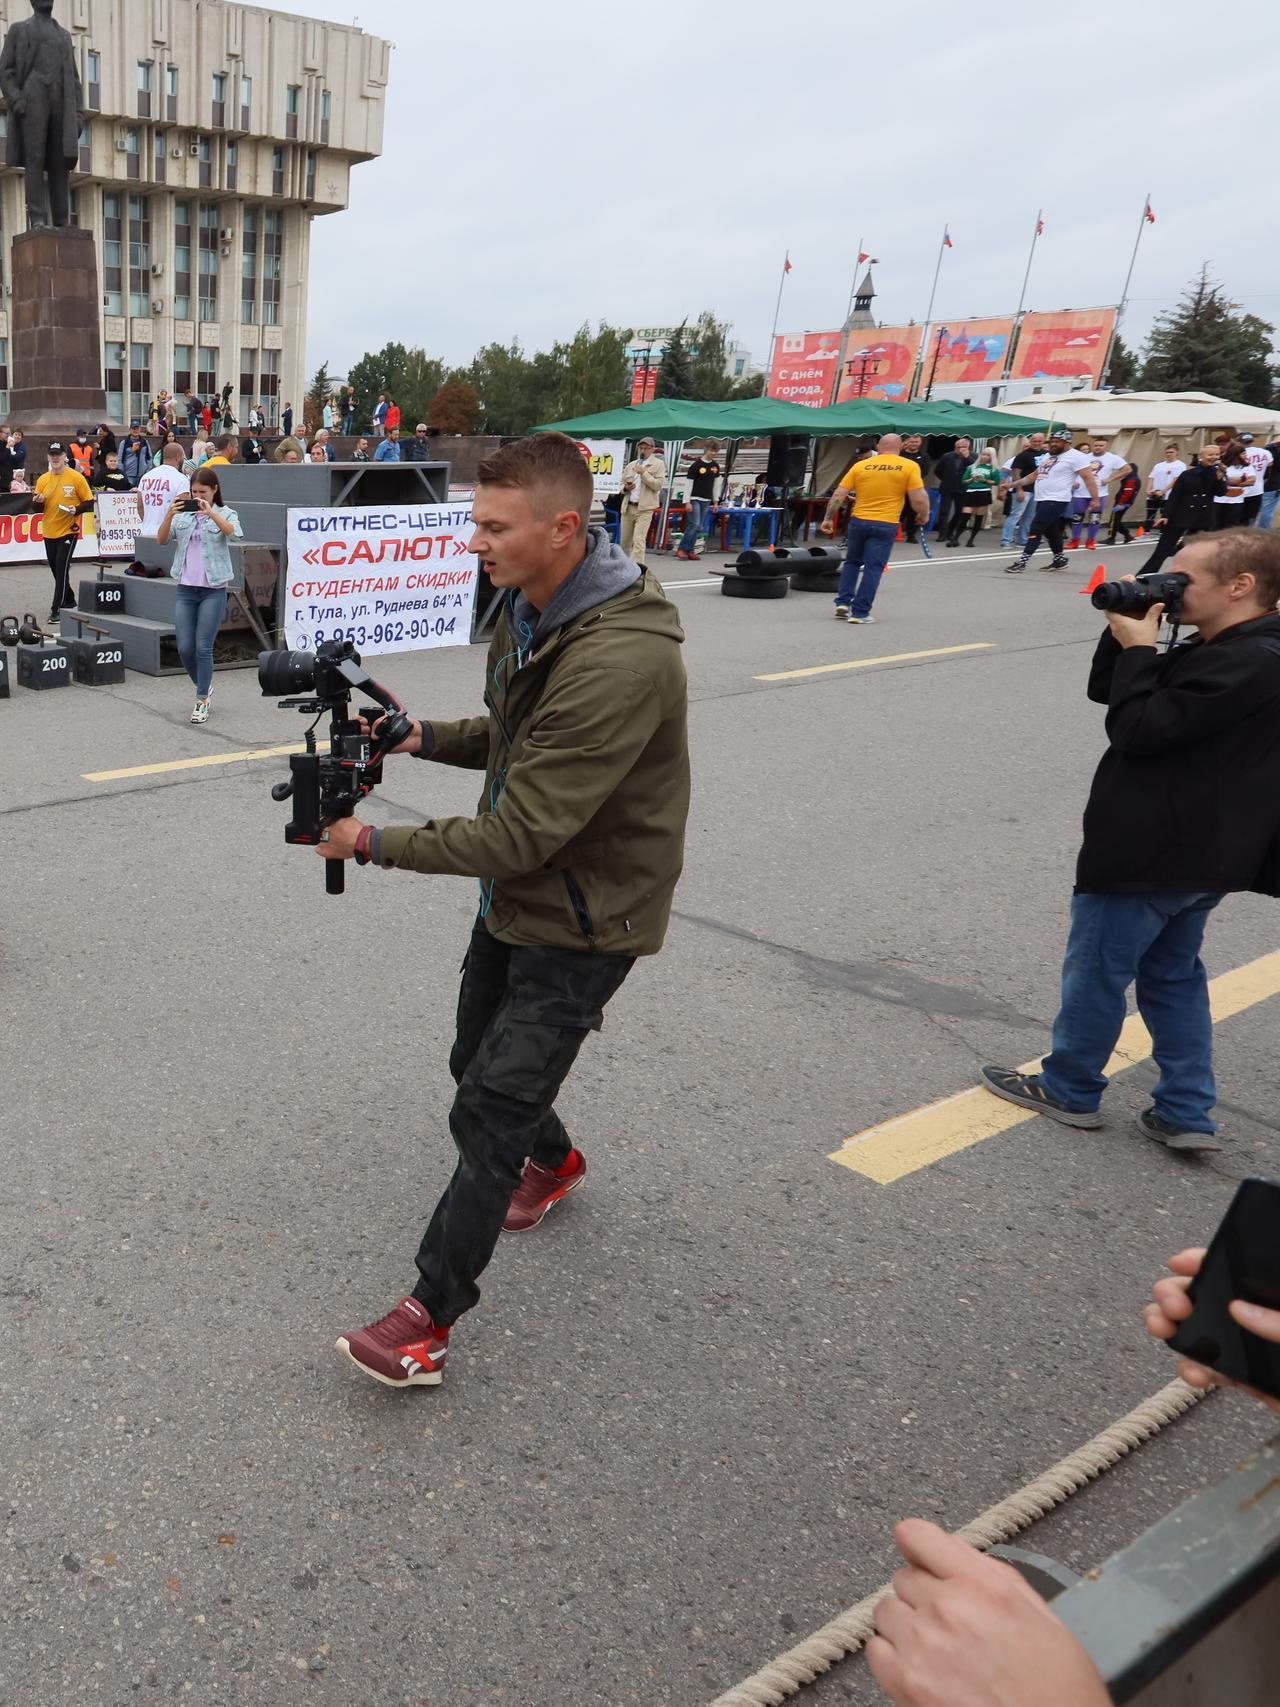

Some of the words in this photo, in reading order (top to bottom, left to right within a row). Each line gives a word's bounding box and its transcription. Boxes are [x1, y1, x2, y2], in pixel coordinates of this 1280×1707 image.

[637, 327, 695, 338] СБЕРБНК
[779, 369, 788, 380] С
[790, 367, 824, 381] днём
[776, 385, 824, 397] города,
[864, 464, 904, 472] СУДЬЯ
[142, 478, 170, 492] ТУЛА
[144, 493, 163, 506] 875
[128, 506, 137, 515] ТГ
[101, 528, 142, 540] 8-953-962
[100, 542, 136, 551] www.fit
[302, 536, 468, 566] «САЛЮТ»
[292, 576, 400, 599] СТУДЕНТАМ
[406, 570, 472, 590] СКИДКИ!
[98, 590, 121, 602] 180
[295, 609, 304, 621] г.
[309, 605, 346, 623] Тула,
[351, 603, 371, 620] ул.
[375, 599, 428, 617] Руднева
[314, 617, 456, 649] 8953-962-90-04
[42, 656, 67, 672] 200
[96, 650, 122, 665] 220
